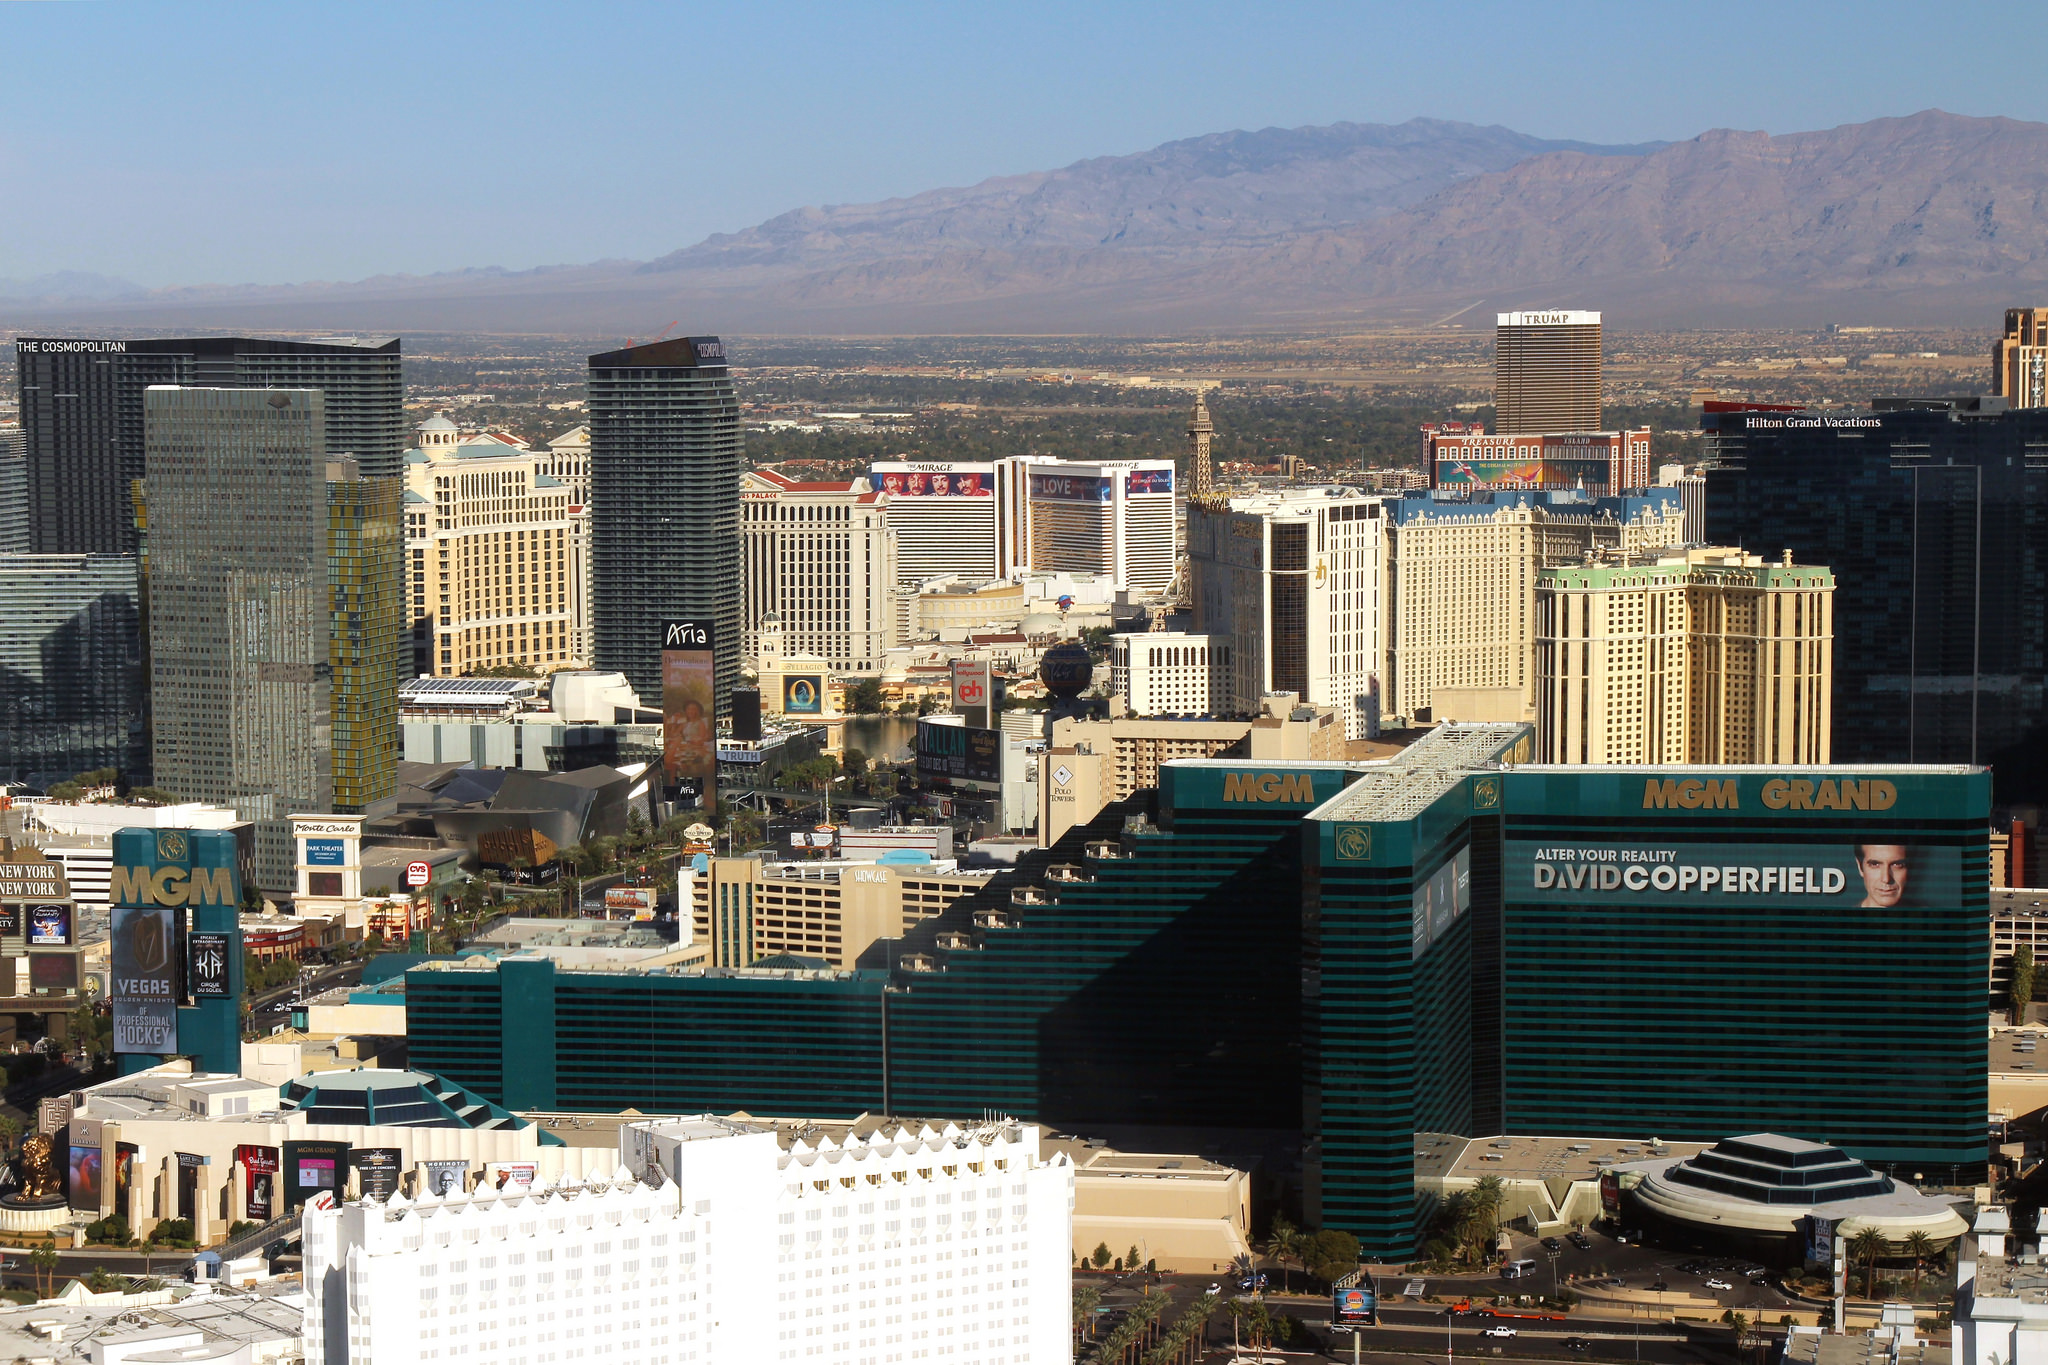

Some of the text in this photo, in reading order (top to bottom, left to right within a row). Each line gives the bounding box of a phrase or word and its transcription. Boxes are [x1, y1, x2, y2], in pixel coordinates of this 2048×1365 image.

[1525, 315, 1569, 325] TRUMP
[17, 341, 125, 353] THE COSMOPOLITAN
[1746, 417, 1881, 428] Hilton Grand Vacations
[1461, 438, 1516, 446] TREASURE
[1563, 437, 1591, 445] ISLAND
[917, 463, 953, 471] MIRAGE
[1043, 479, 1071, 495] LOVE
[667, 623, 707, 646] Aria
[783, 663, 823, 671] BELLAGIO
[956, 670, 985, 678] hollywood
[724, 751, 758, 761] TRUTH
[680, 786, 695, 795] Aria
[1054, 787, 1072, 795] POLO
[1223, 773, 1314, 803] MGM
[1643, 779, 1898, 811] MGM GRAND
[295, 824, 355, 833] Monte Carlo
[1535, 849, 1677, 862] ALTER YOUR REALITY
[0, 865, 56, 879] NEW YORK
[854, 870, 887, 882] SHOWCASE
[0, 882, 56, 896] NEW YORK
[109, 865, 235, 906] MGM
[117, 979, 170, 995] VEGAS
[139, 1006, 147, 1015] OF
[117, 1015, 170, 1026] PROFESSIONAL
[118, 1026, 171, 1045] HOCKEY
